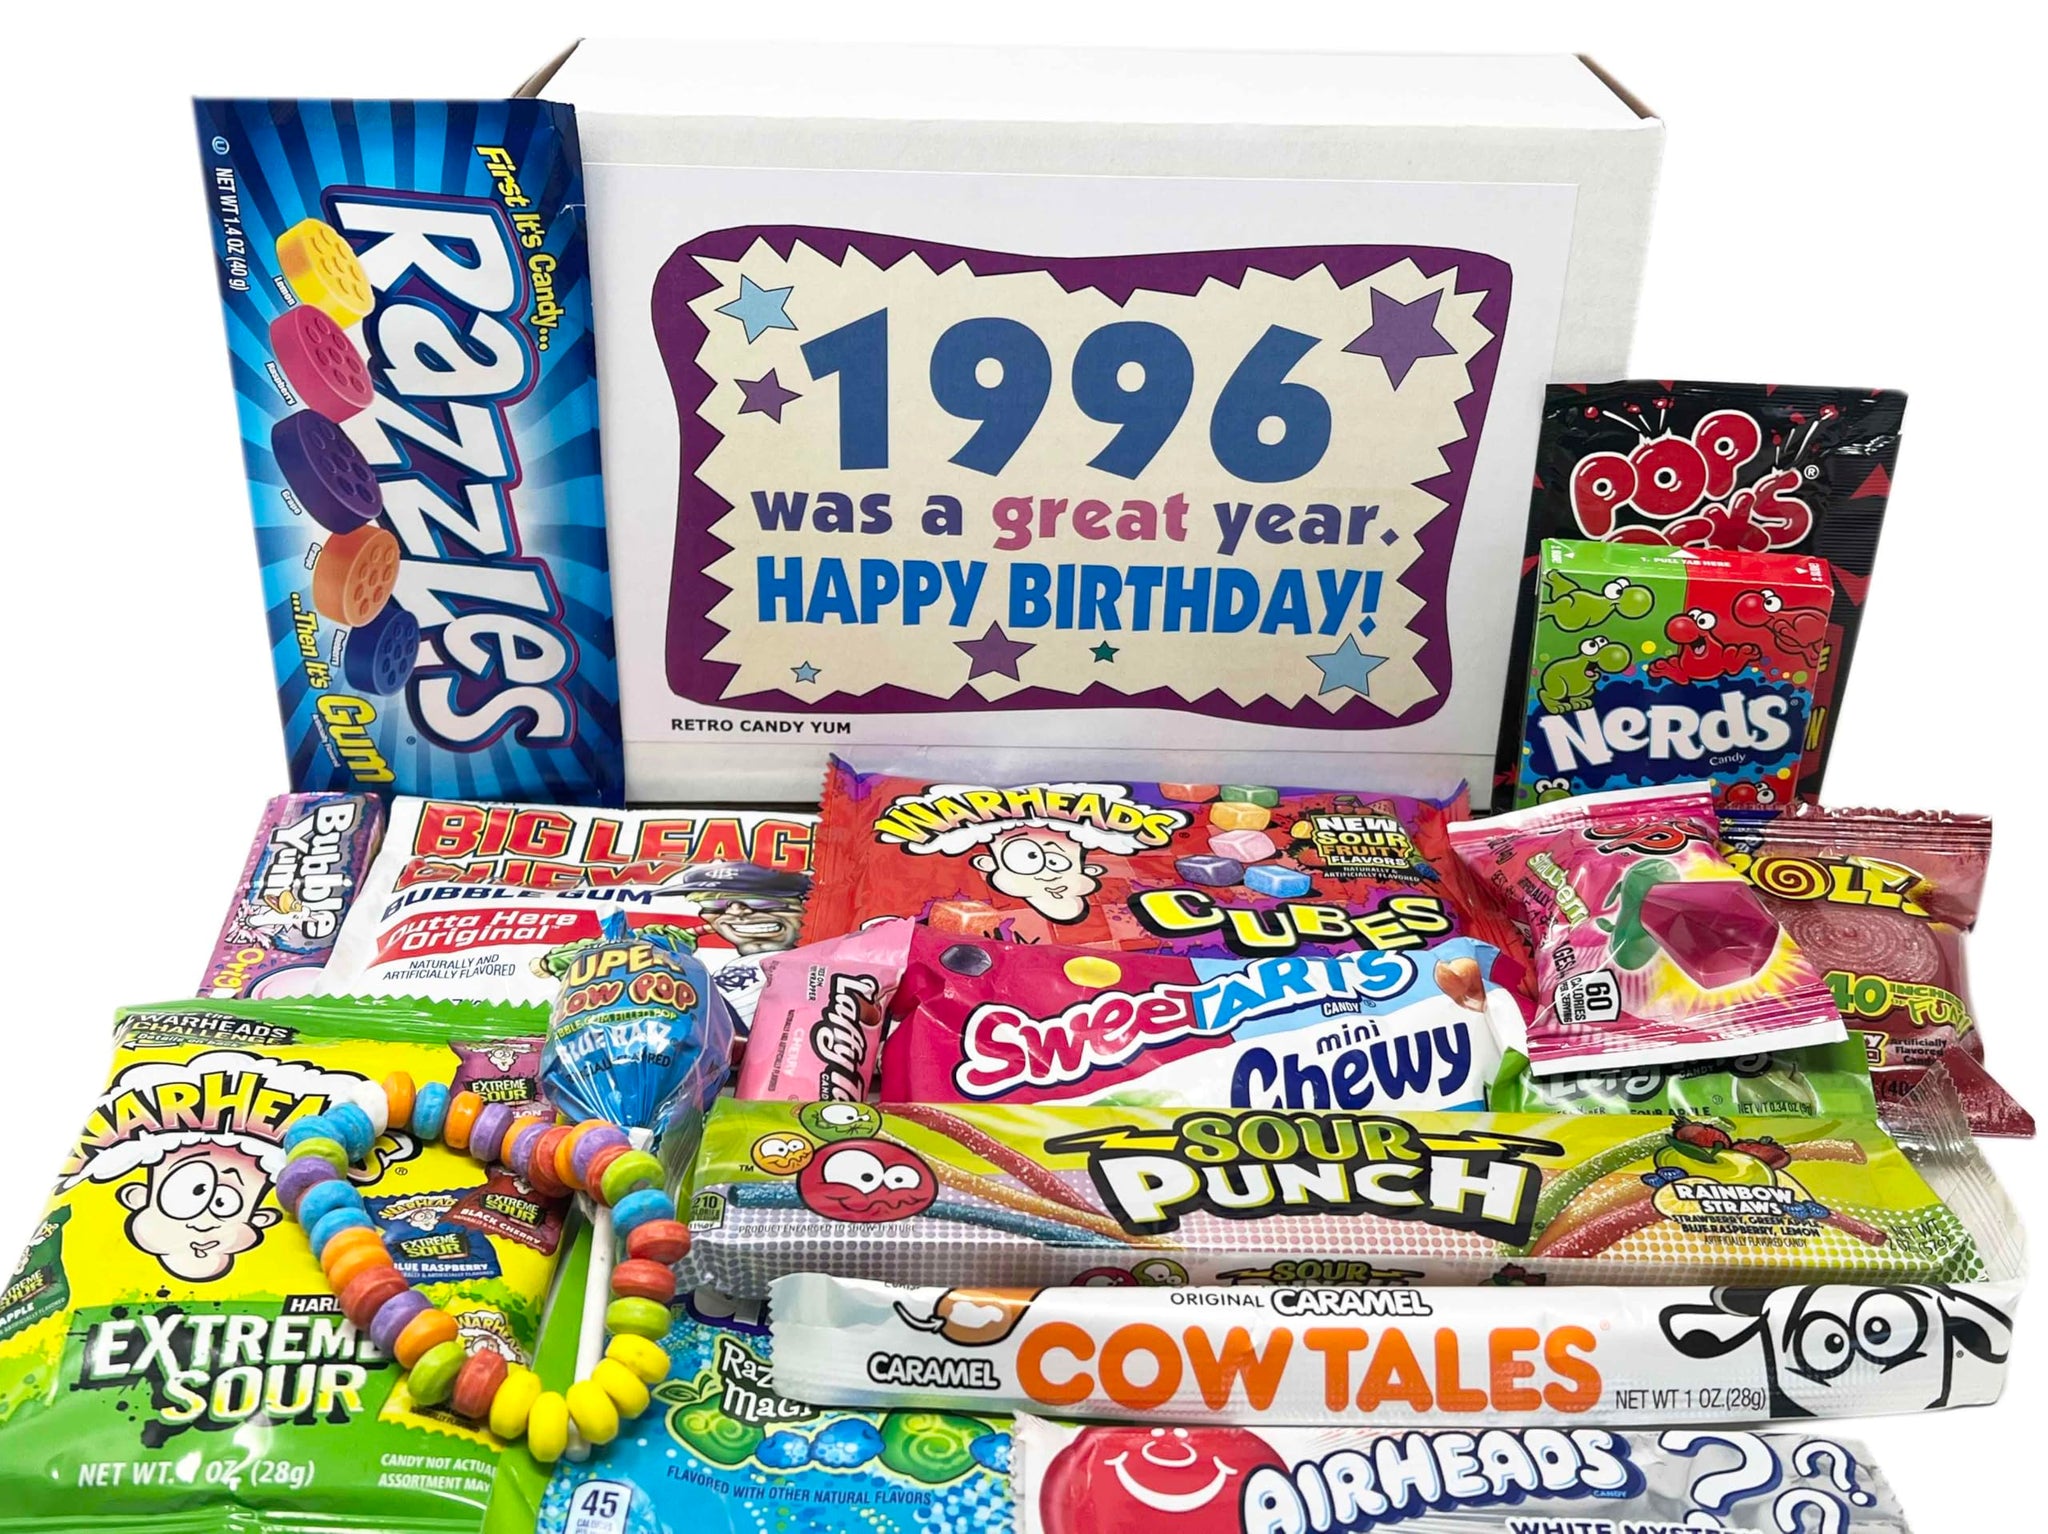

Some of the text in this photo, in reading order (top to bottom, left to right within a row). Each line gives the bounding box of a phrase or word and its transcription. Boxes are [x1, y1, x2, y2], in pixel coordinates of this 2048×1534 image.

[215, 167, 235, 194] NET
[219, 194, 239, 215] WT
[475, 145, 532, 209] First
[512, 209, 544, 250] It's
[223, 215, 242, 236] 1.4
[226, 236, 245, 256] OZ
[274, 276, 297, 307] Lemon
[265, 362, 297, 406] Raspberry
[800, 306, 1333, 484] 1996
[1570, 409, 1762, 540] POP
[281, 490, 301, 515] Grape
[751, 490, 1399, 554] was a great year.
[1653, 557, 1679, 565] PULL
[1702, 560, 1732, 568] HERE
[757, 555, 1385, 636] HAPPY BIRTHDAY!
[305, 659, 332, 690] It's
[316, 694, 396, 784] Gum
[670, 717, 852, 736] RETRO CANDY YUM
[1709, 752, 1746, 767] Candy
[873, 787, 1178, 847] WARHEADS
[413, 801, 817, 873] BIG LEAG
[1316, 832, 1409, 848] SOUR
[1322, 845, 1407, 858] FRUITY
[1330, 855, 1408, 866] FLAVORS
[298, 803, 356, 940] Bubble
[381, 886, 654, 923] BUBBLE GUM
[388, 911, 578, 946] Outta Here
[1138, 888, 1448, 953] CUBES
[402, 924, 551, 952] Original
[383, 963, 516, 981] ARTIFICIALLY FLAVORED
[409, 953, 500, 970] NATURALLY AND
[629, 972, 697, 1014] POP
[1570, 976, 1587, 1022] CALORIES
[1586, 981, 1613, 1011] 60
[1823, 970, 1889, 1017] 40
[653, 1007, 678, 1020] POP
[1323, 1000, 1362, 1016] CANDY
[140, 1014, 288, 1038] WARHEADS
[815, 976, 877, 1073] Laffy
[1317, 1019, 1381, 1056] mini
[782, 1027, 806, 1077] CHERRY
[1890, 1038, 1948, 1049] Artificially
[1894, 1046, 1944, 1056] Flavored
[1232, 1022, 1472, 1110] Chewy
[472, 1078, 528, 1093] EXTREME
[1738, 1103, 1754, 1115] NET
[1754, 1103, 1769, 1115] WT
[1769, 1102, 1788, 1114] 0.34
[1788, 1102, 1799, 1113] OZ
[1183, 1114, 1422, 1162] SOUR
[485, 1193, 540, 1213] EXTREME
[1099, 1155, 1529, 1225] PUNCH
[1674, 1184, 1794, 1204] RAINBOW
[378, 1195, 459, 1219] WARHEAD
[485, 1199, 538, 1225] SOUR
[1672, 1214, 1746, 1225] STRAWBERRY,
[1748, 1216, 1784, 1226] GREEN
[1701, 1200, 1783, 1215] STRAWS
[460, 1208, 499, 1227] BLACK
[499, 1221, 542, 1245] CHERRY
[738, 1224, 781, 1234] PRODUCT
[783, 1224, 832, 1233] ENLARGED
[1780, 1226, 1821, 1238] LEMON
[401, 1233, 461, 1250] EXTREME
[406, 1243, 462, 1259] SOUR
[1748, 1236, 1783, 1247] FLAVORED
[1783, 1237, 1808, 1248] CANDY
[421, 1262, 488, 1272] RASPBERRY
[1272, 1259, 1370, 1282] SOUR
[1171, 1288, 1433, 1318] ORIGINAL CARAMEL
[868, 1353, 1001, 1389] CARAMEL
[1016, 1321, 1604, 1415] COW TALES
[160, 1363, 368, 1424] SOUR
[1615, 1390, 1648, 1409] NET
[1652, 1390, 1680, 1409] WT
[1684, 1390, 1692, 1408] 1
[78, 1459, 315, 1490] NET WT. (28g)
[380, 1453, 424, 1468] CANDY
[425, 1455, 451, 1470] NOT
[378, 1472, 491, 1492] ASSORTMENT MAY
[667, 1465, 932, 1506] FLAVORED WITH OTHER NATURAL FLAVORS
[1243, 1429, 1627, 1534] AIRHEADS
[1593, 1489, 1628, 1498] CANDY
[581, 1489, 620, 1518] 45
